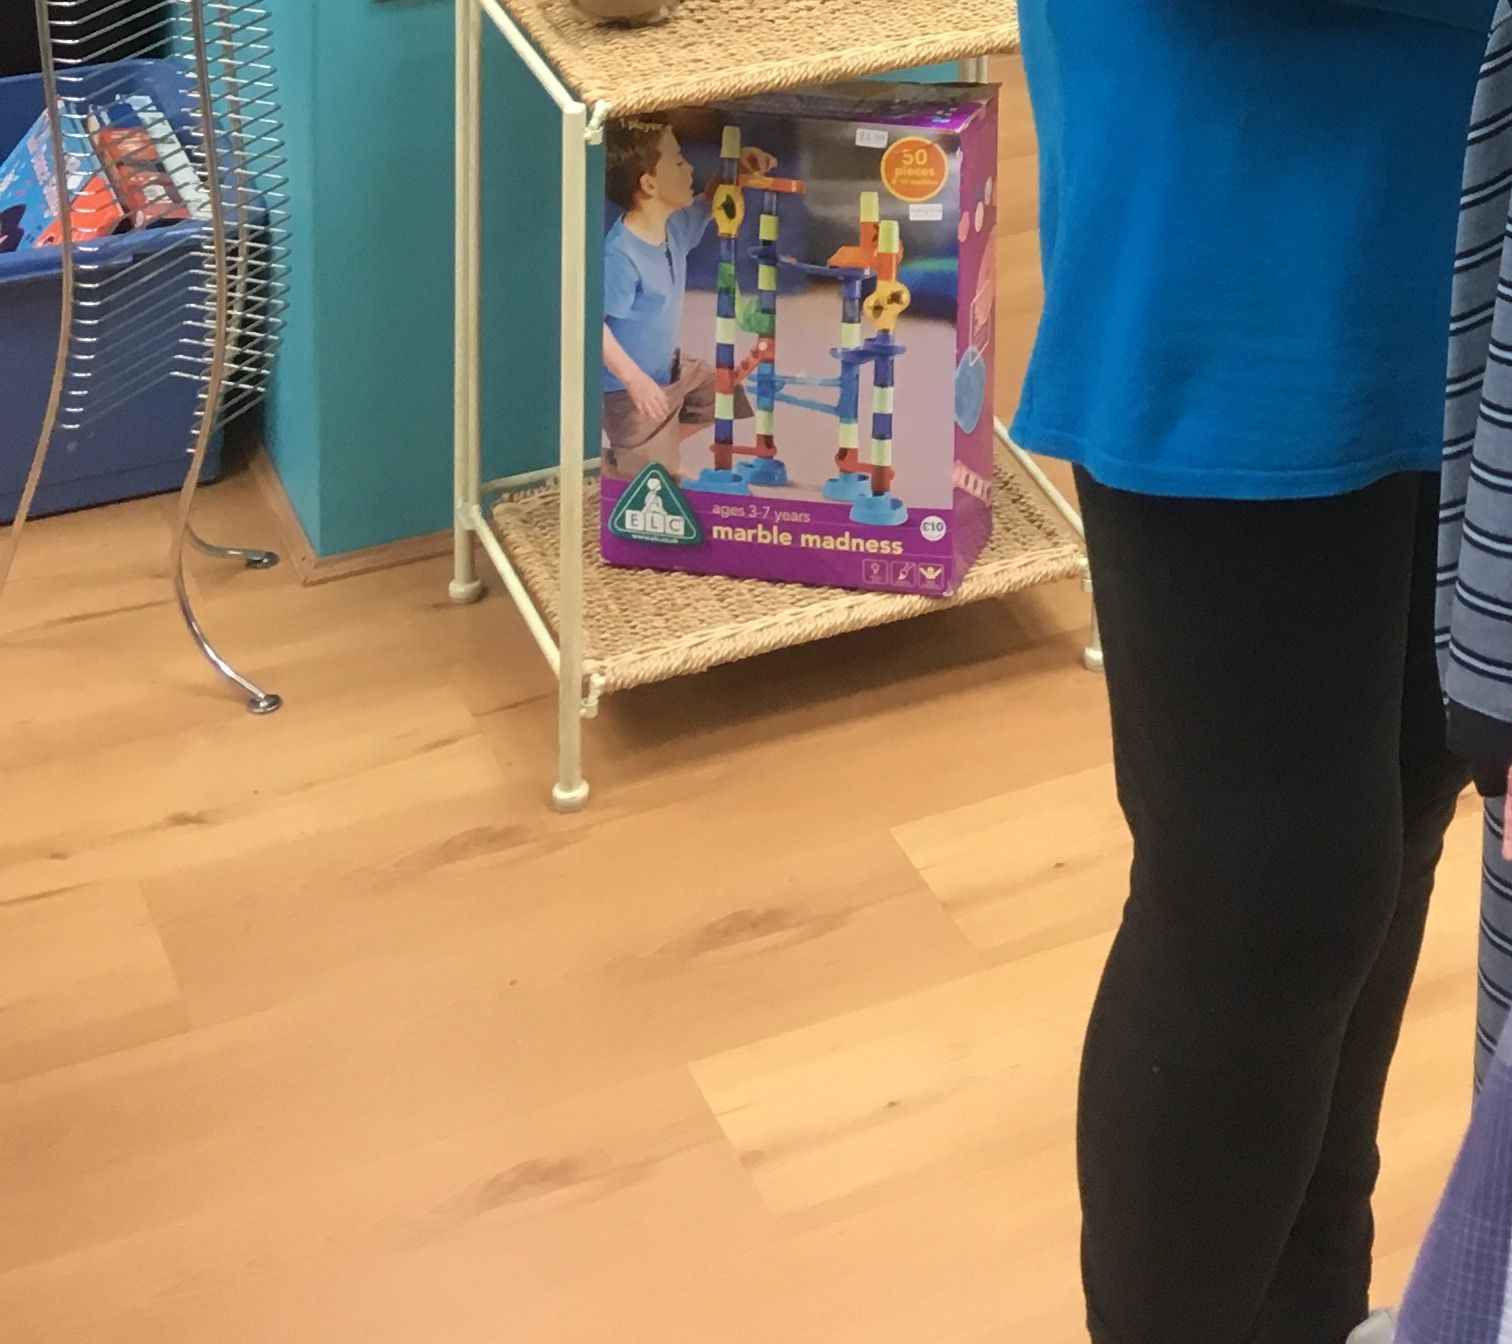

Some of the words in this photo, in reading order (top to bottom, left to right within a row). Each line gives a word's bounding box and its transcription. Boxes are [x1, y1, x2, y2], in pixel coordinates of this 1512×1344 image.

[902, 148, 927, 166] 50
[894, 166, 935, 178] pieces
[713, 502, 745, 518] ages
[749, 504, 772, 519] 3-7
[775, 508, 811, 524] years
[630, 518, 682, 534] ELC
[922, 520, 945, 533] £10
[712, 524, 793, 547] marble
[800, 528, 904, 556] madness
